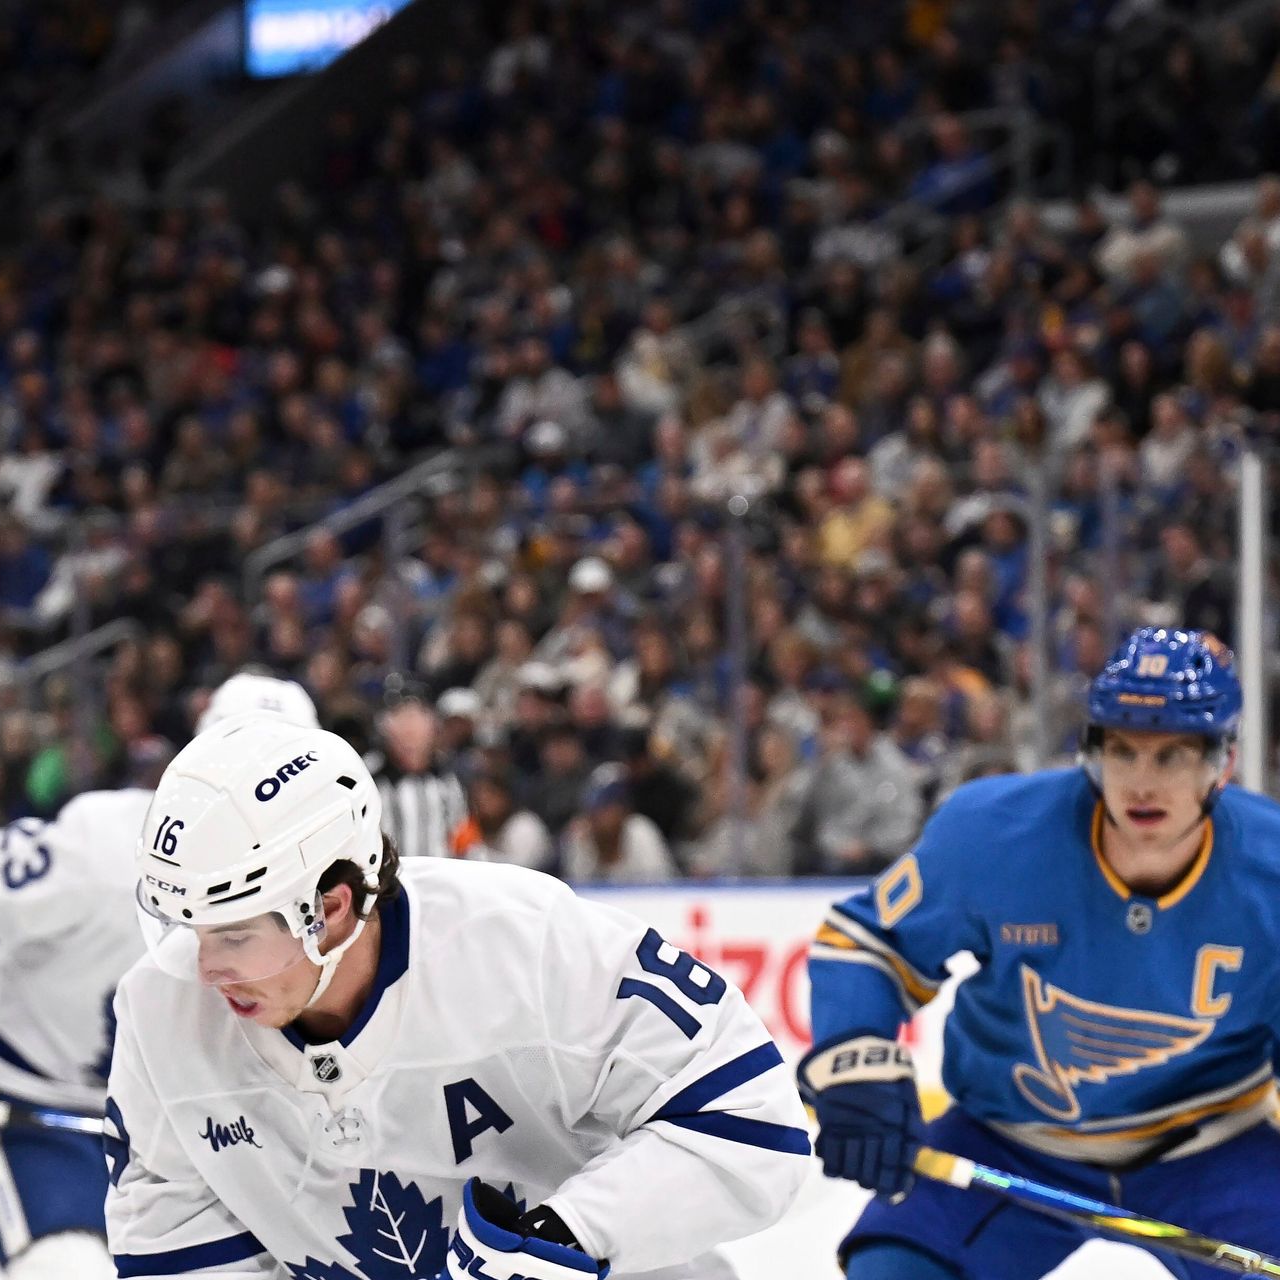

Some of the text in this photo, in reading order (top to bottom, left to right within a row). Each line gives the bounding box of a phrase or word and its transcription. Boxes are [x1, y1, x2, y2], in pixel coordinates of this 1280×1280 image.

[153, 815, 184, 856] 16
[145, 874, 187, 897] CCM
[874, 852, 923, 930] 0
[616, 927, 727, 1040] 16
[1191, 944, 1245, 1019] C
[198, 1115, 263, 1153] Milk
[442, 1078, 514, 1164] A
